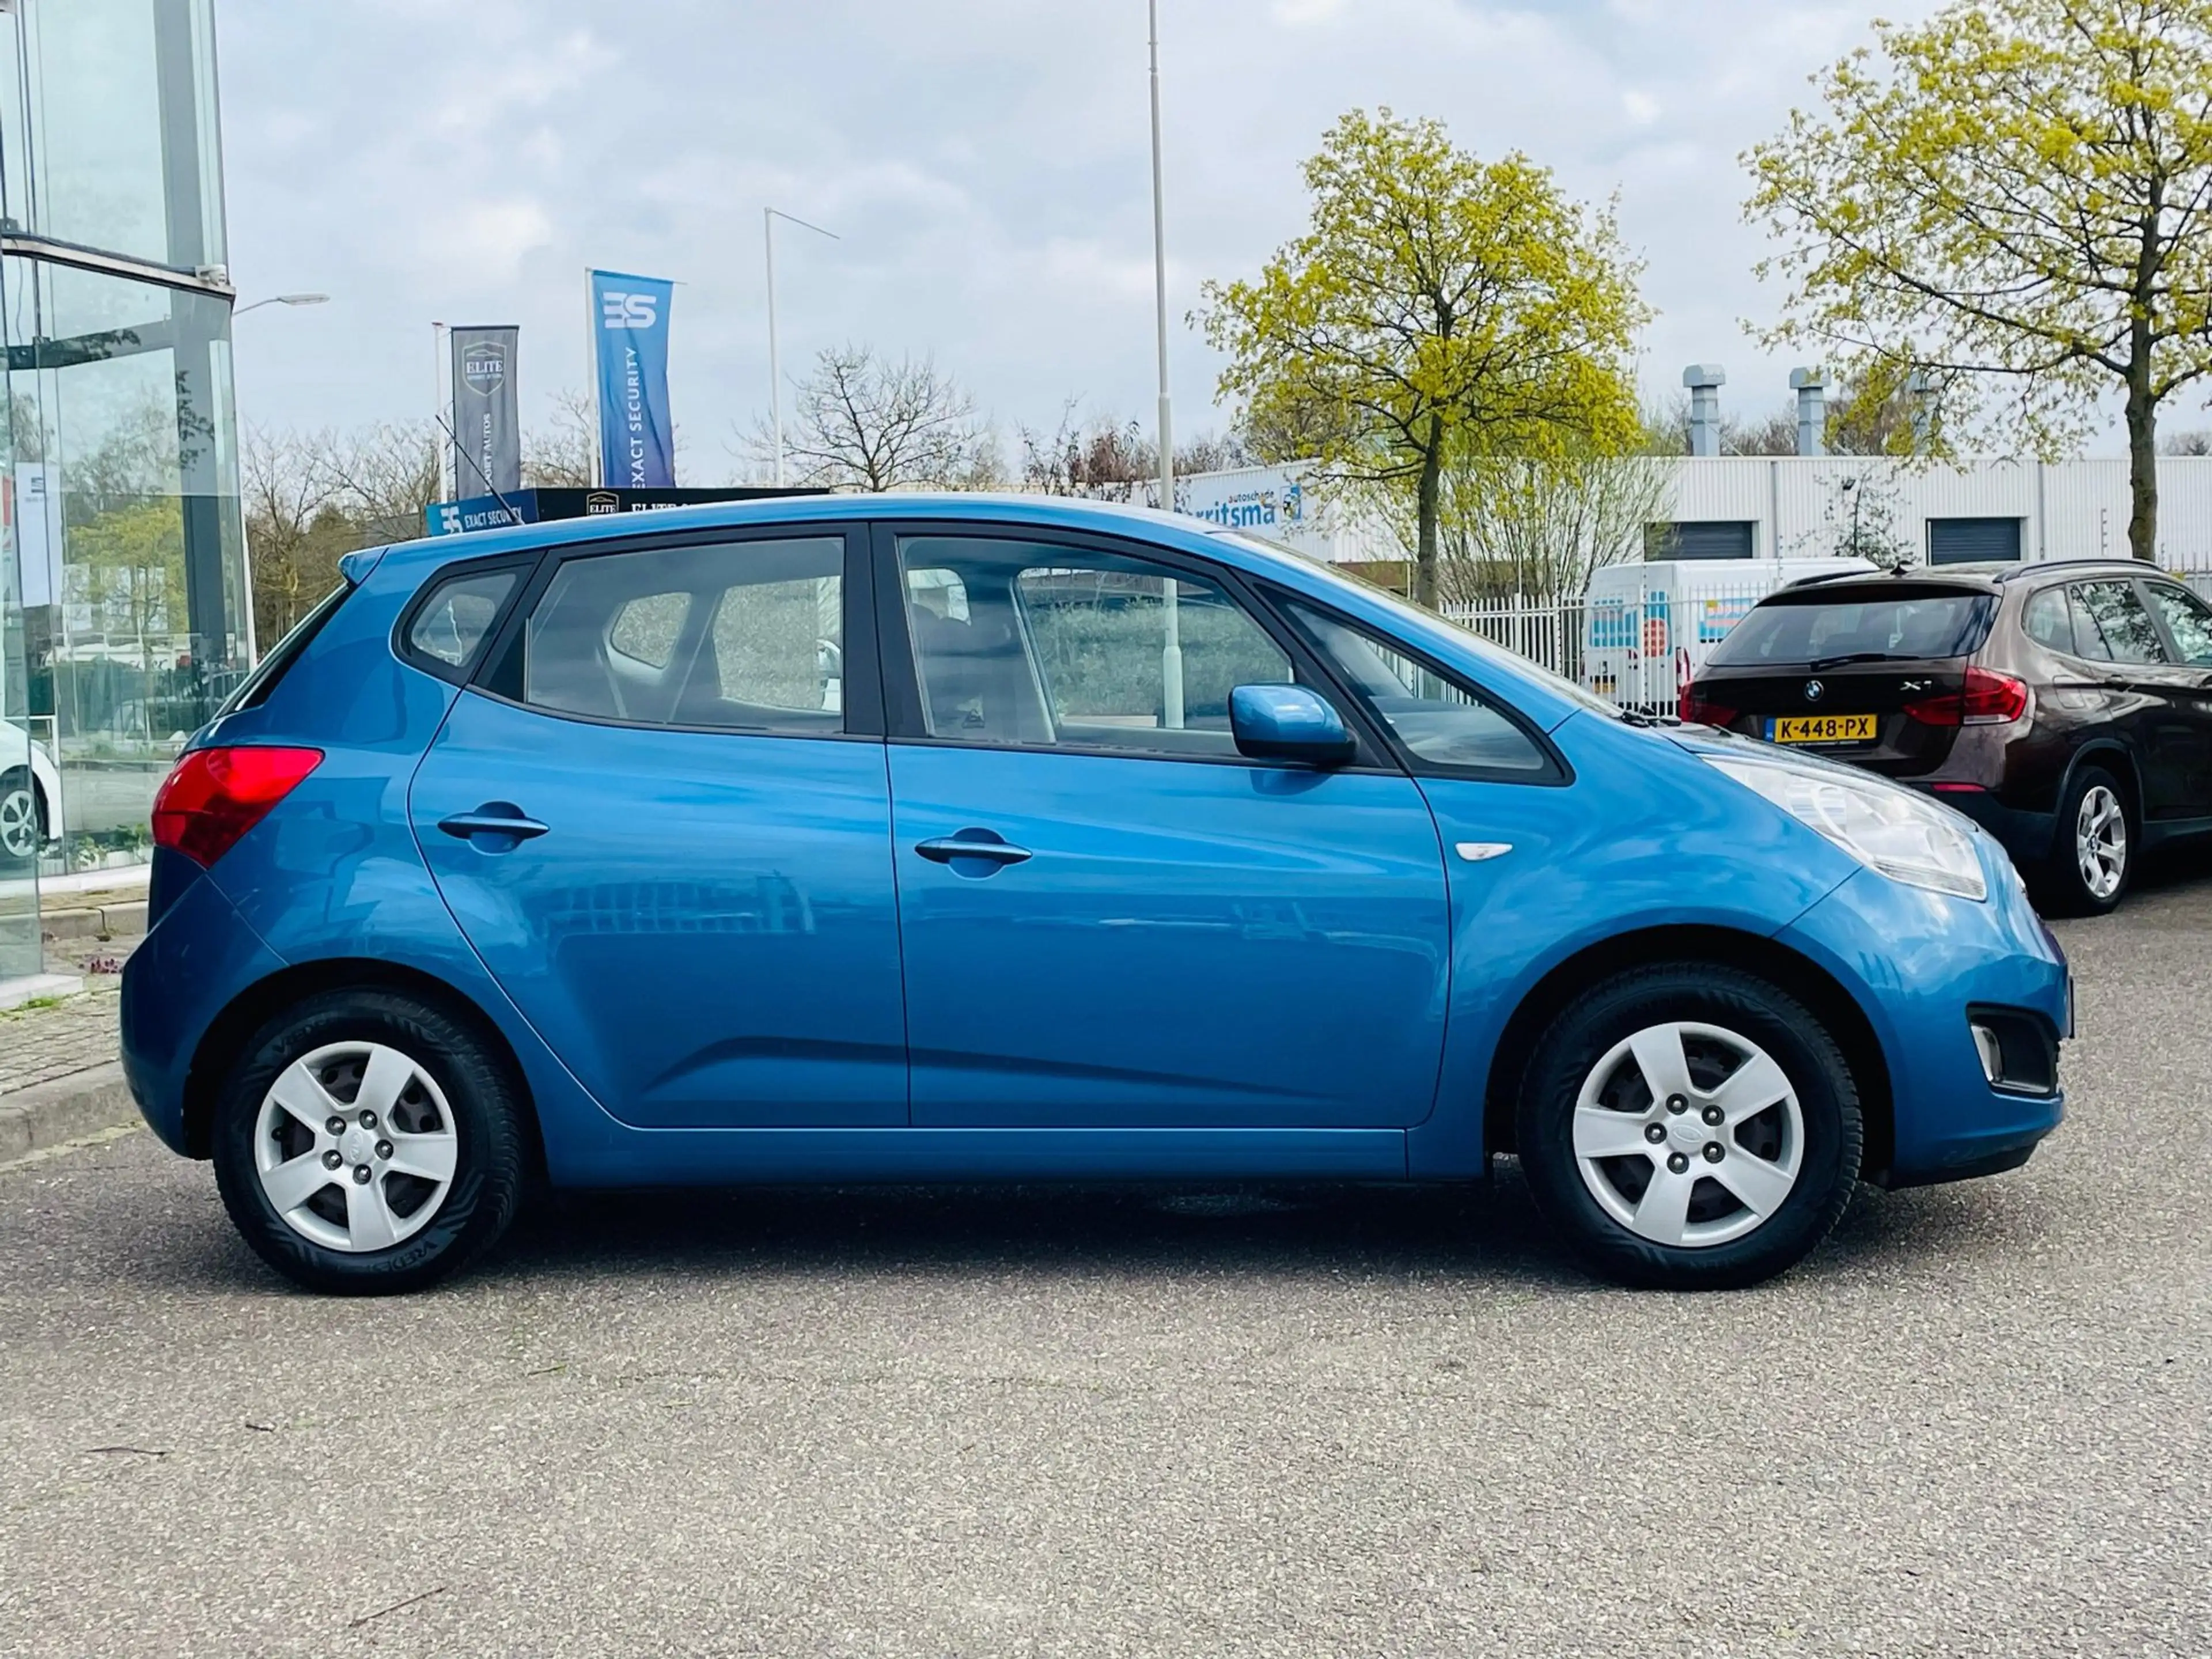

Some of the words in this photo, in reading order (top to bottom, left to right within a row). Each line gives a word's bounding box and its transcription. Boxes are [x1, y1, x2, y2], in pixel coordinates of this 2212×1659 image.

[467, 360, 503, 374] ELITE
[625, 347, 642, 432] SECURITY
[464, 512, 486, 528] EXACT
[488, 506, 522, 525] SECUY
[590, 504, 616, 513] ELITE
[1781, 718, 1869, 738] K-448-PX
